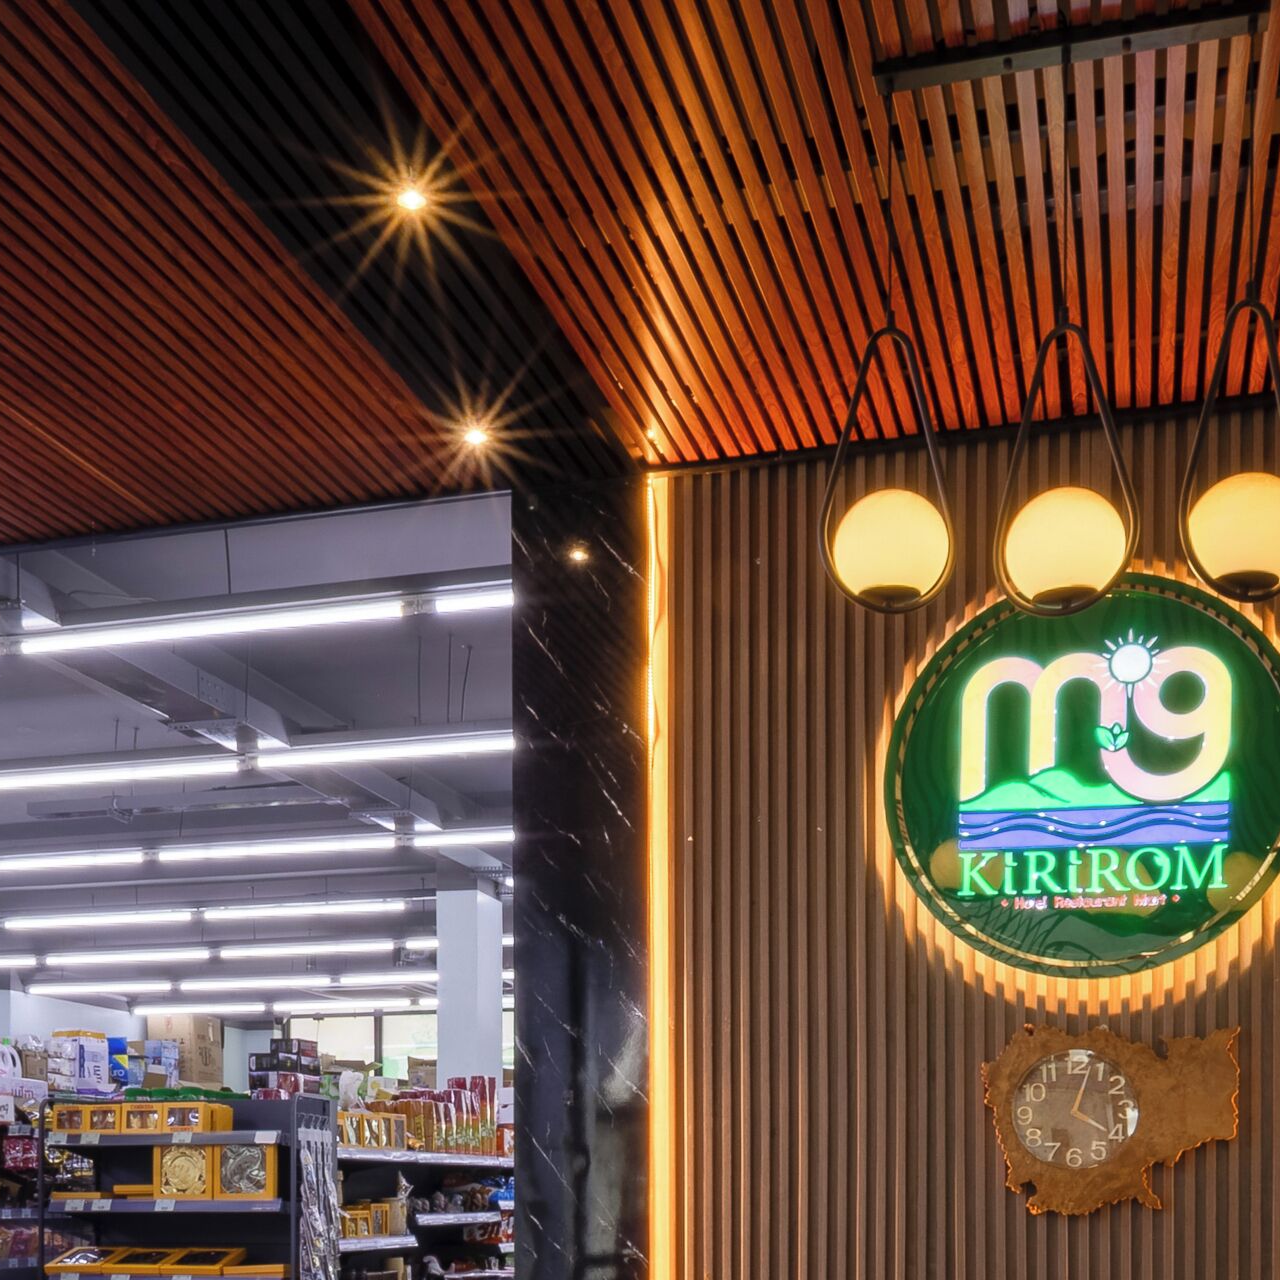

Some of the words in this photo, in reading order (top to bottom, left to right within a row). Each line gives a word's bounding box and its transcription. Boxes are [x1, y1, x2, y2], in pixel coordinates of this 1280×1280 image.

[1040, 1063, 1057, 1082] 11
[1066, 1057, 1089, 1075] 12
[1096, 1063, 1106, 1081] 1
[1024, 1083, 1046, 1102] 10
[1108, 1076, 1126, 1094] 2
[1017, 1106, 1033, 1125] 9
[1118, 1100, 1135, 1119] 3
[1026, 1128, 1042, 1147] 8
[1108, 1124, 1125, 1143] 4
[1045, 1142, 1061, 1161] 7
[1066, 1148, 1082, 1167] 6
[1091, 1141, 1107, 1161] 5
